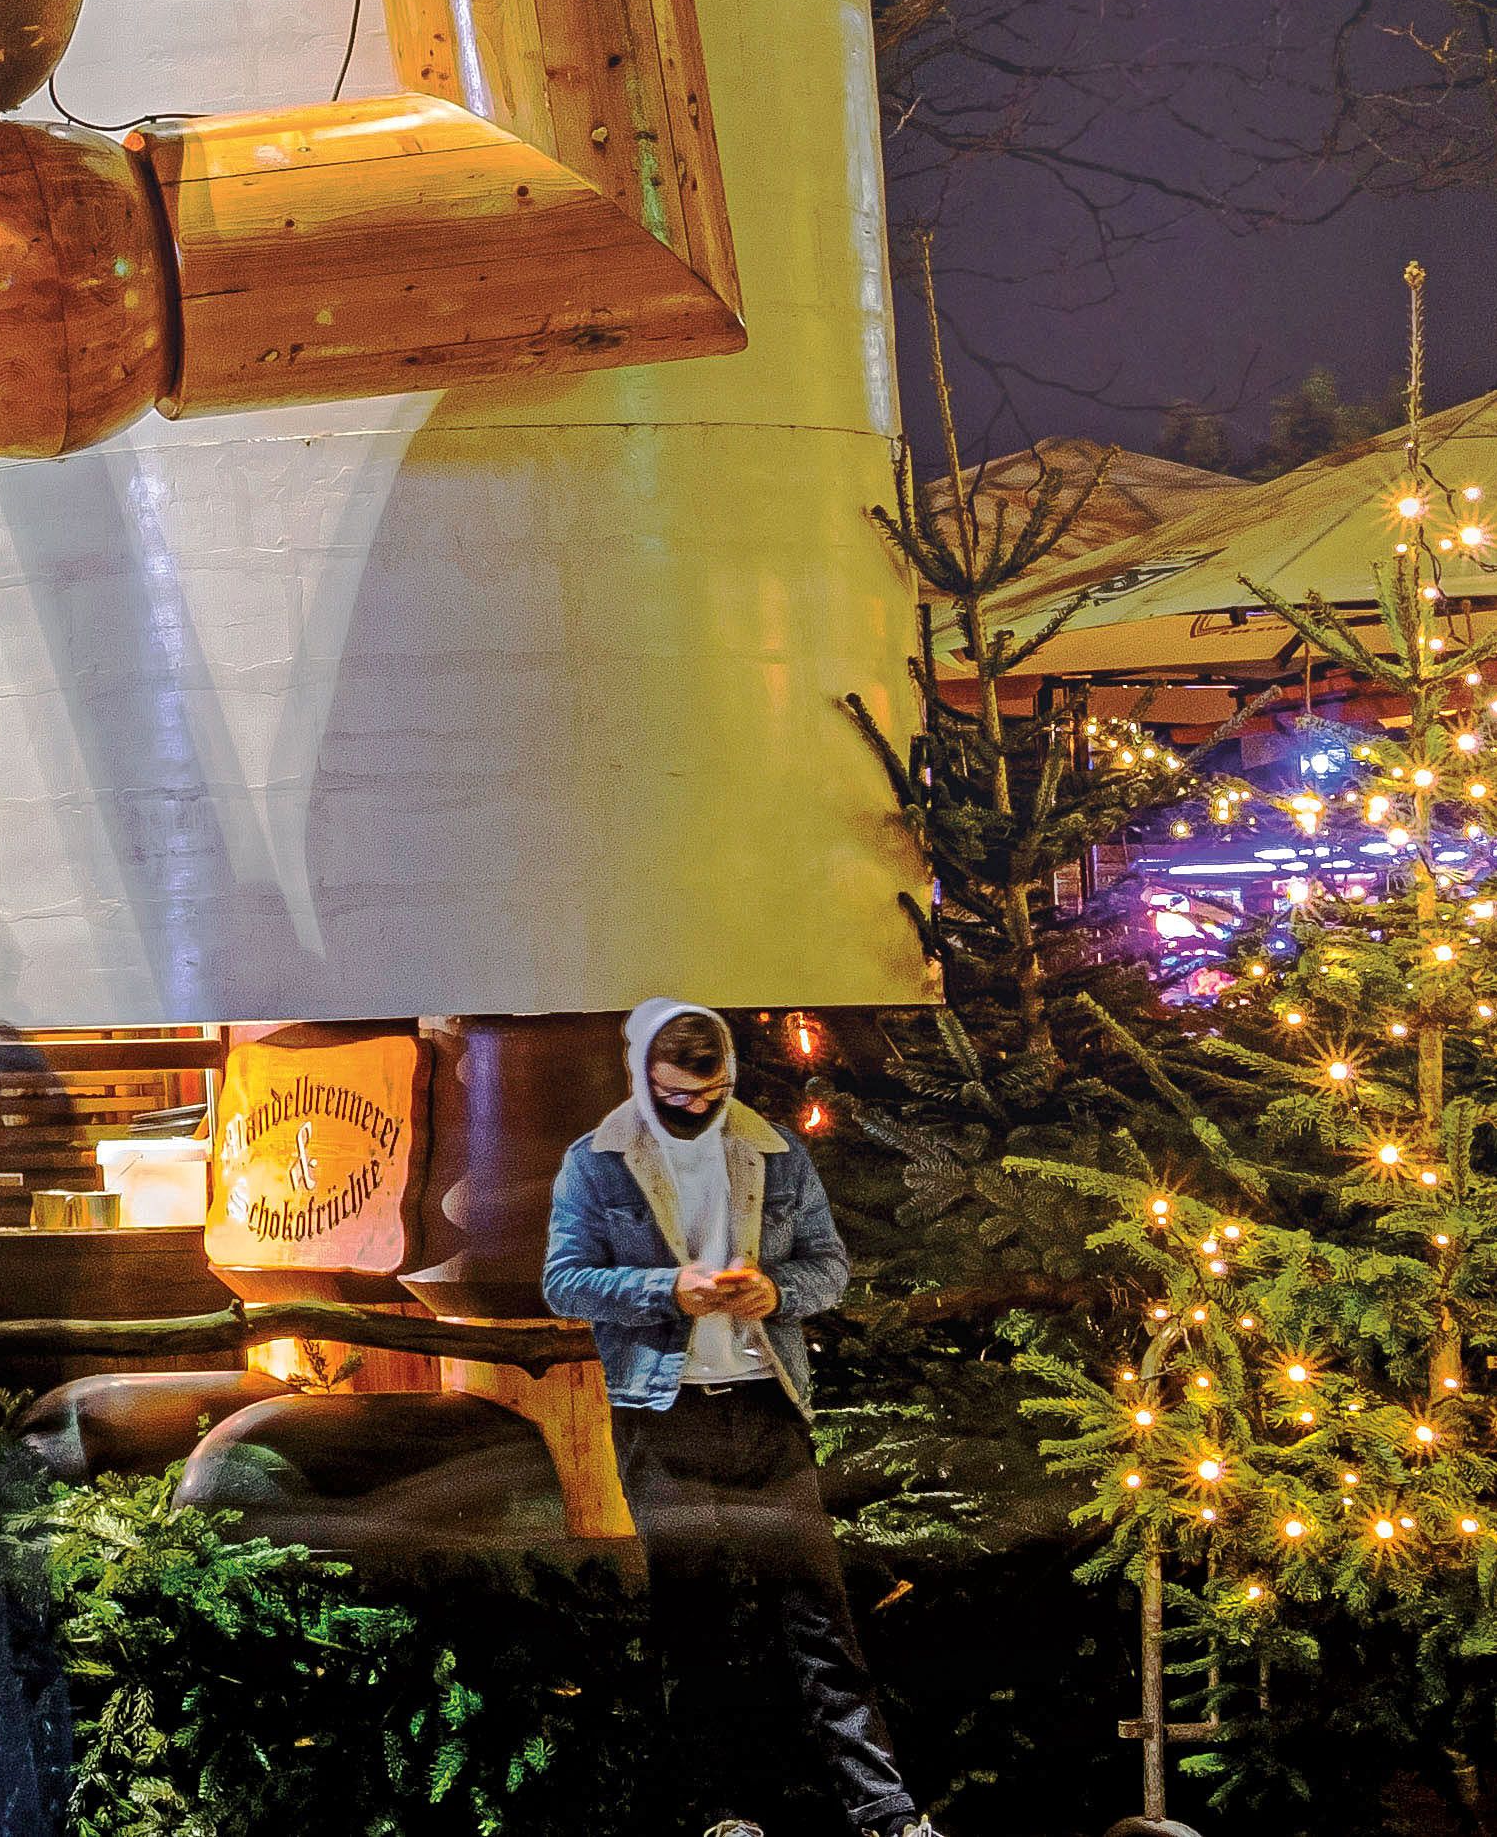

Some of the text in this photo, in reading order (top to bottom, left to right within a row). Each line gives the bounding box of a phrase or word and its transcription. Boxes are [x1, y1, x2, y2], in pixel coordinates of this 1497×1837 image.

[221, 1074, 403, 1160] Mandelbrennerei
[288, 1120, 318, 1192] &
[226, 1158, 383, 1244] Schokofrüchte
